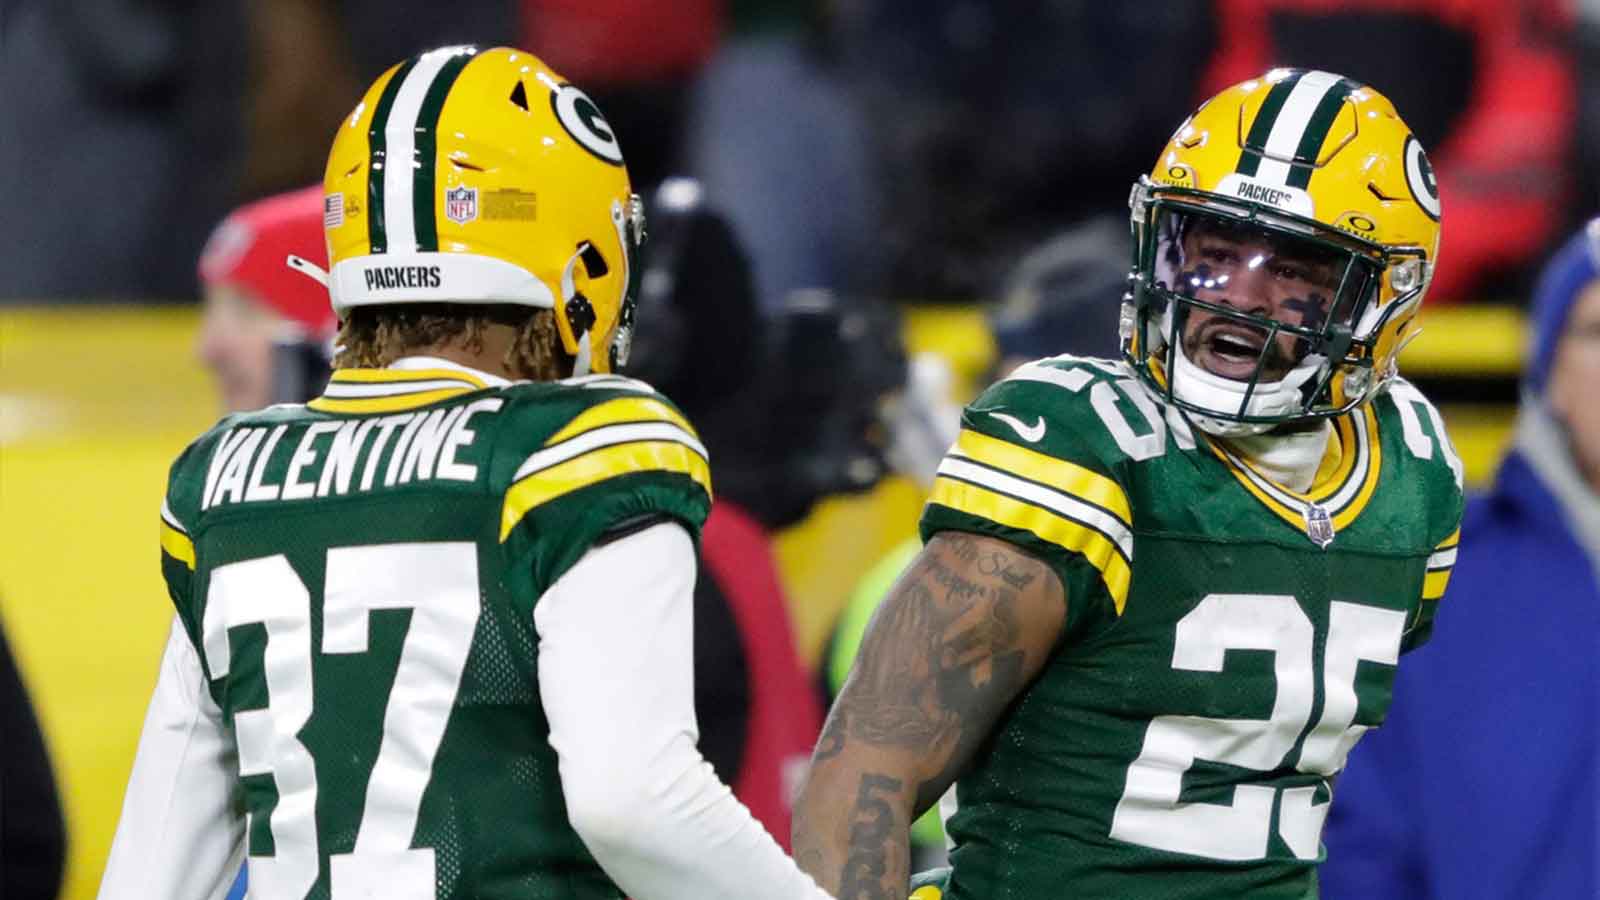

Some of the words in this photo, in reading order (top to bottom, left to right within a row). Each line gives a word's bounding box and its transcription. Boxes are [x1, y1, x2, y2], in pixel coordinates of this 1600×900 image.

[364, 265, 441, 291] PACKERS
[202, 397, 503, 510] VALENTINE
[202, 541, 481, 900] 37
[1109, 593, 1408, 862] 25
